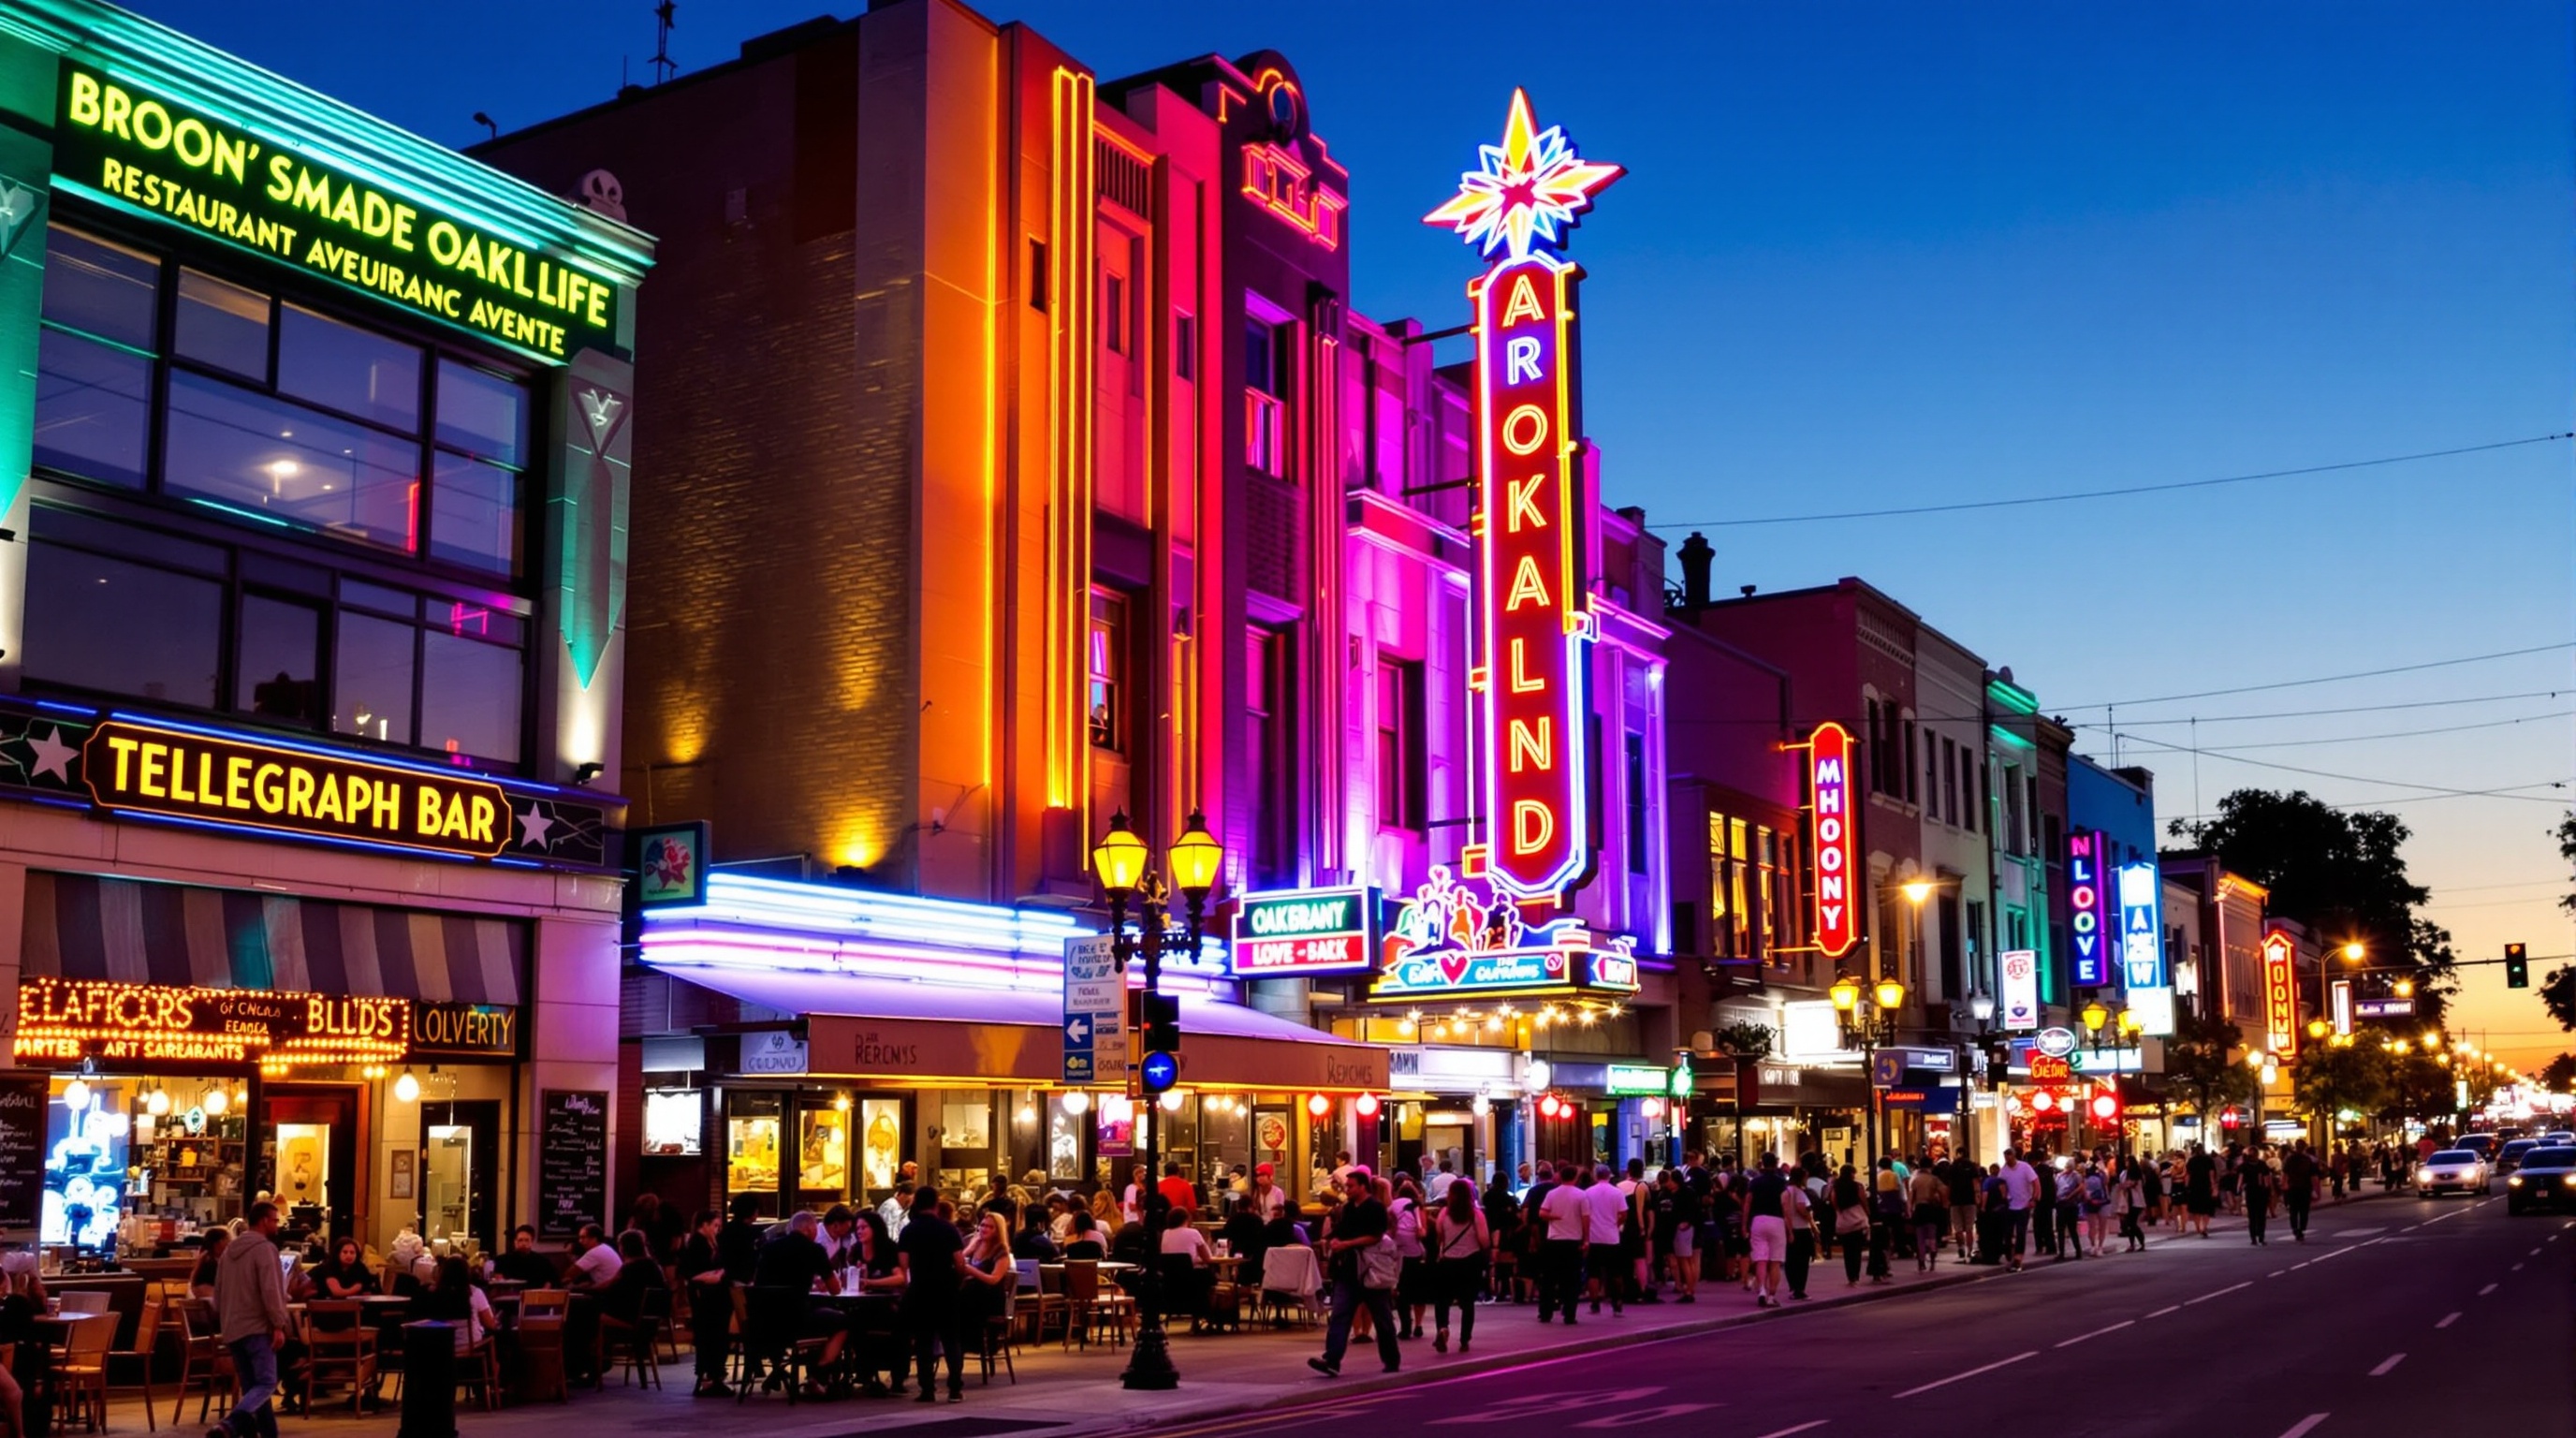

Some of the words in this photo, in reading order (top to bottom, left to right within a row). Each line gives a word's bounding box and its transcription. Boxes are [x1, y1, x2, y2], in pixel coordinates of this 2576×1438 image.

[103, 157, 297, 256] RESTAURANT
[306, 238, 461, 317] AVEUIRANC
[469, 298, 565, 355] AVENTE
[267, 155, 417, 252] SMADE
[1502, 274, 1553, 855] AROKALND
[109, 737, 401, 830] TELLEGRAPH
[417, 786, 495, 842] BAR
[1816, 759, 1842, 931] MHOONY
[2071, 837, 2095, 979] NLOOVE
[103, 1041, 139, 1057] ART
